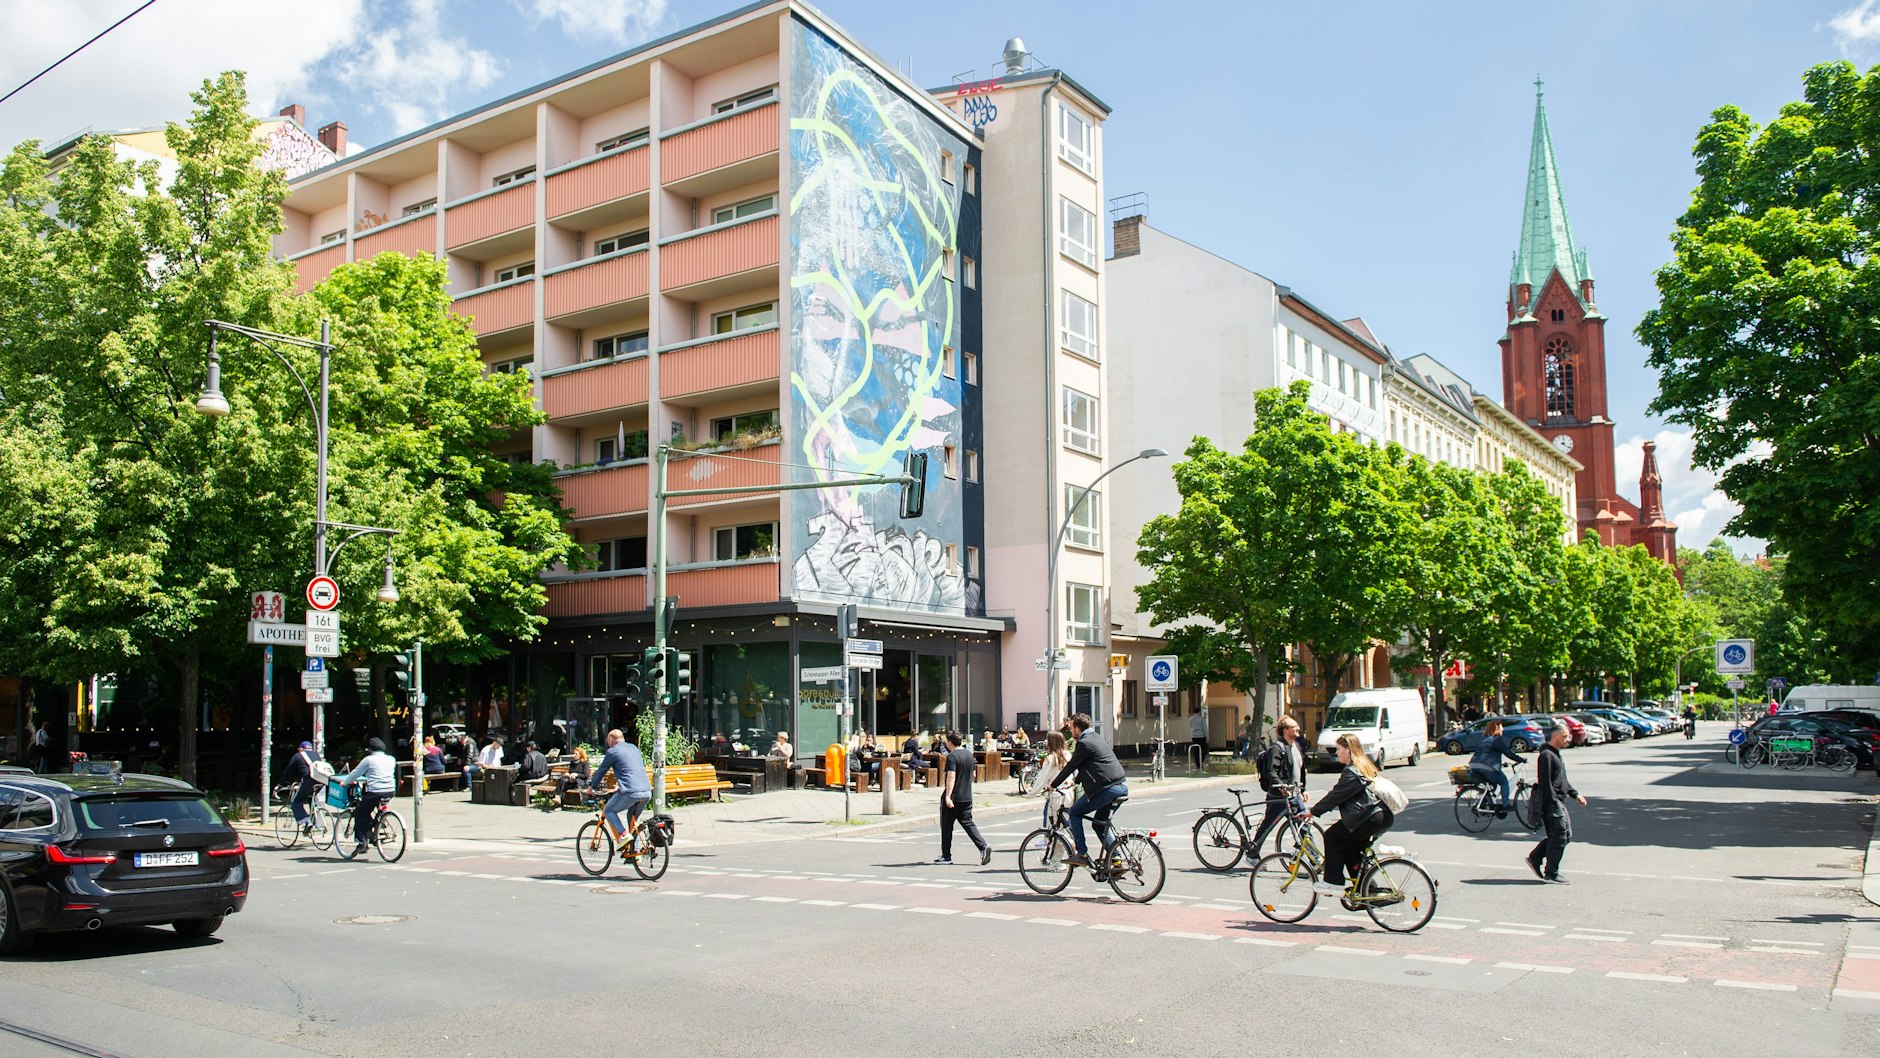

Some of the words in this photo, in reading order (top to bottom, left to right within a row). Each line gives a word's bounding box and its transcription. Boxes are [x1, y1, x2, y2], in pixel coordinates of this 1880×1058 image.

[315, 615, 331, 627] 16t
[314, 634, 332, 643] BVG
[315, 645, 330, 653] frei
[146, 854, 153, 865] D
[159, 853, 173, 864] FF
[175, 852, 194, 864] 252
